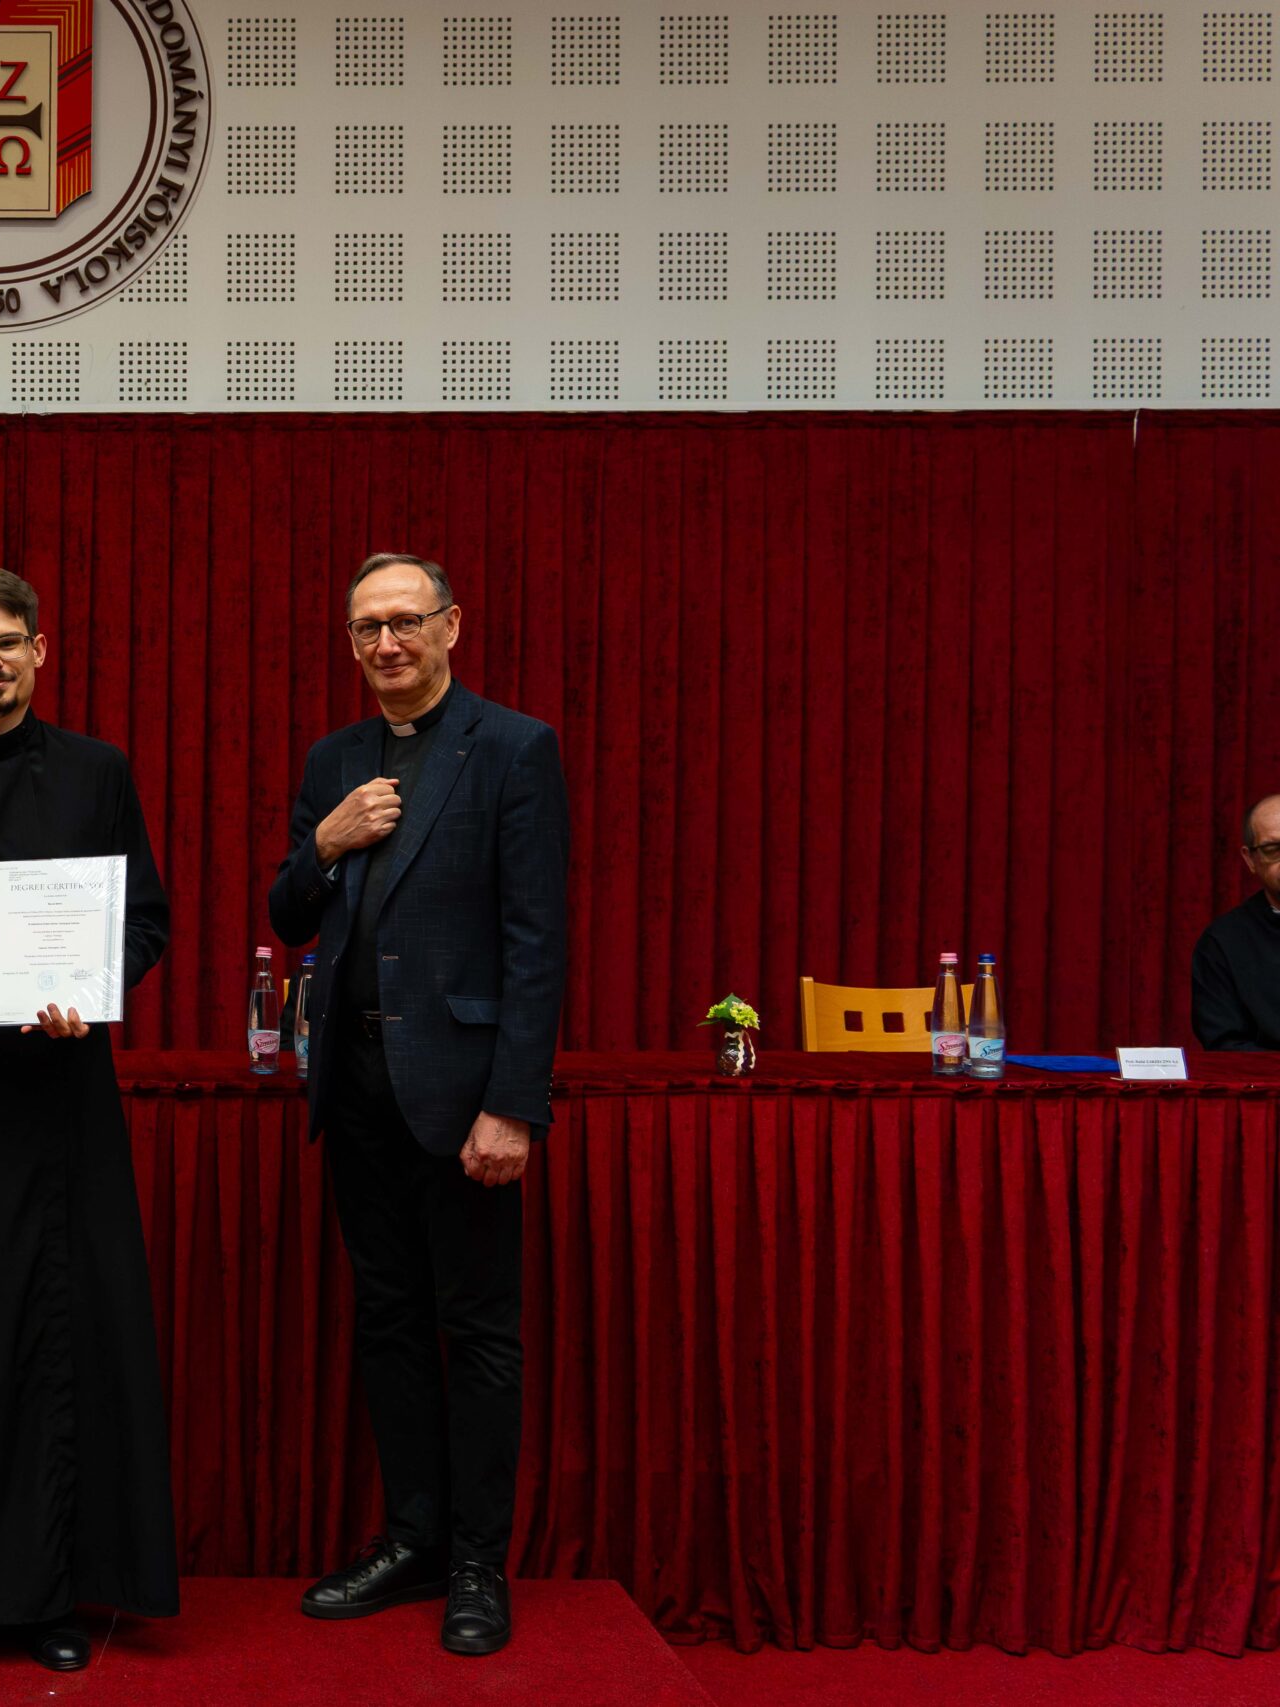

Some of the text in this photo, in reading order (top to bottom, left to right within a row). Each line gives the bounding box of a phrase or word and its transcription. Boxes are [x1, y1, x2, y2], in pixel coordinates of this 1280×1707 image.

[40, 0, 205, 305] DOMÁNYI FŐISKOLA
[10, 882, 46, 892] DEGREE
